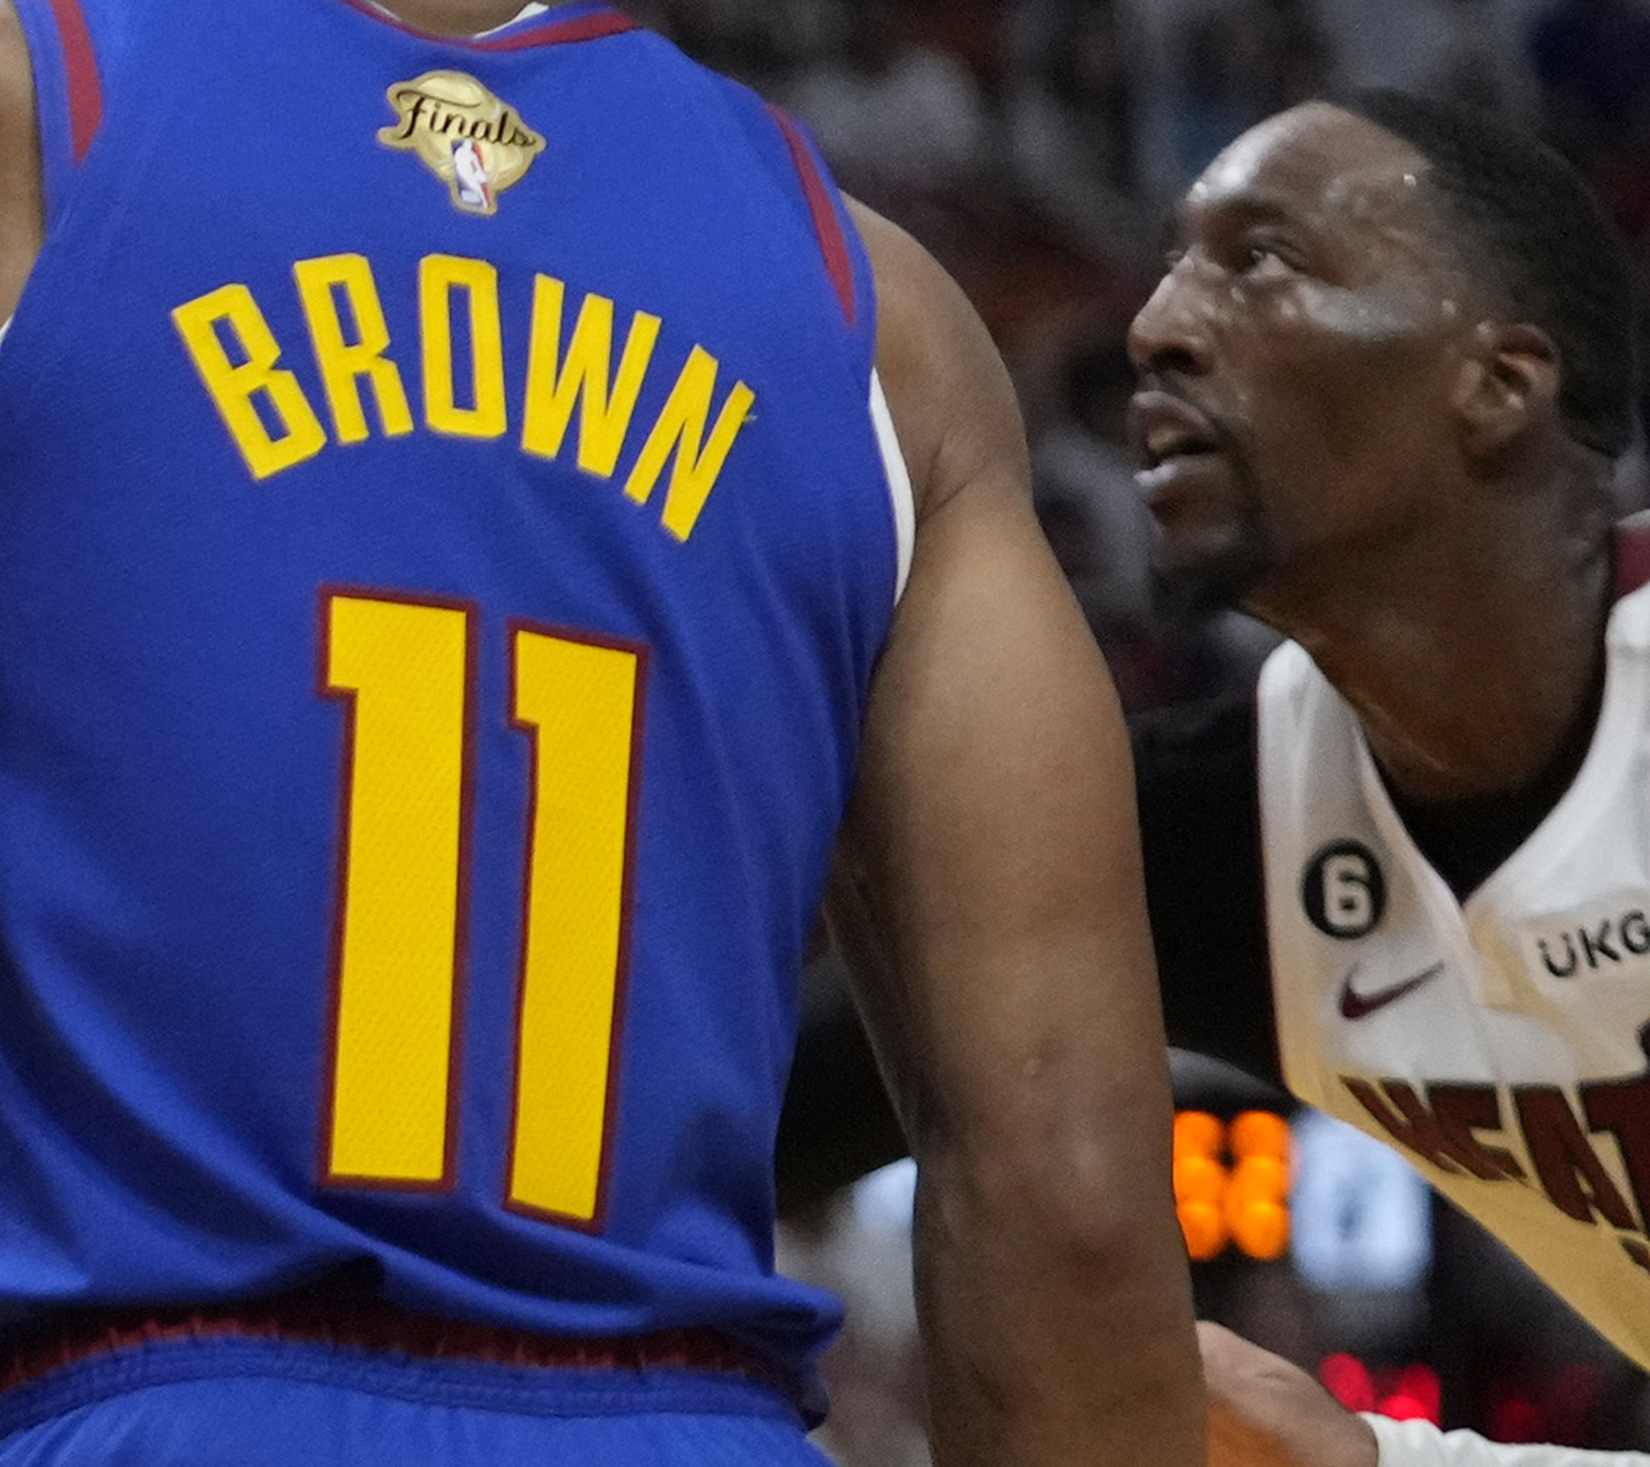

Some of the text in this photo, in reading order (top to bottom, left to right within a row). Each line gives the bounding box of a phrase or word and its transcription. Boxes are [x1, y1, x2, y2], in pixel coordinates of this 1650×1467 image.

[396, 89, 537, 148] Finals
[170, 252, 756, 544] BROWN
[316, 582, 650, 1235] 11
[1536, 911, 1650, 979] UKG
